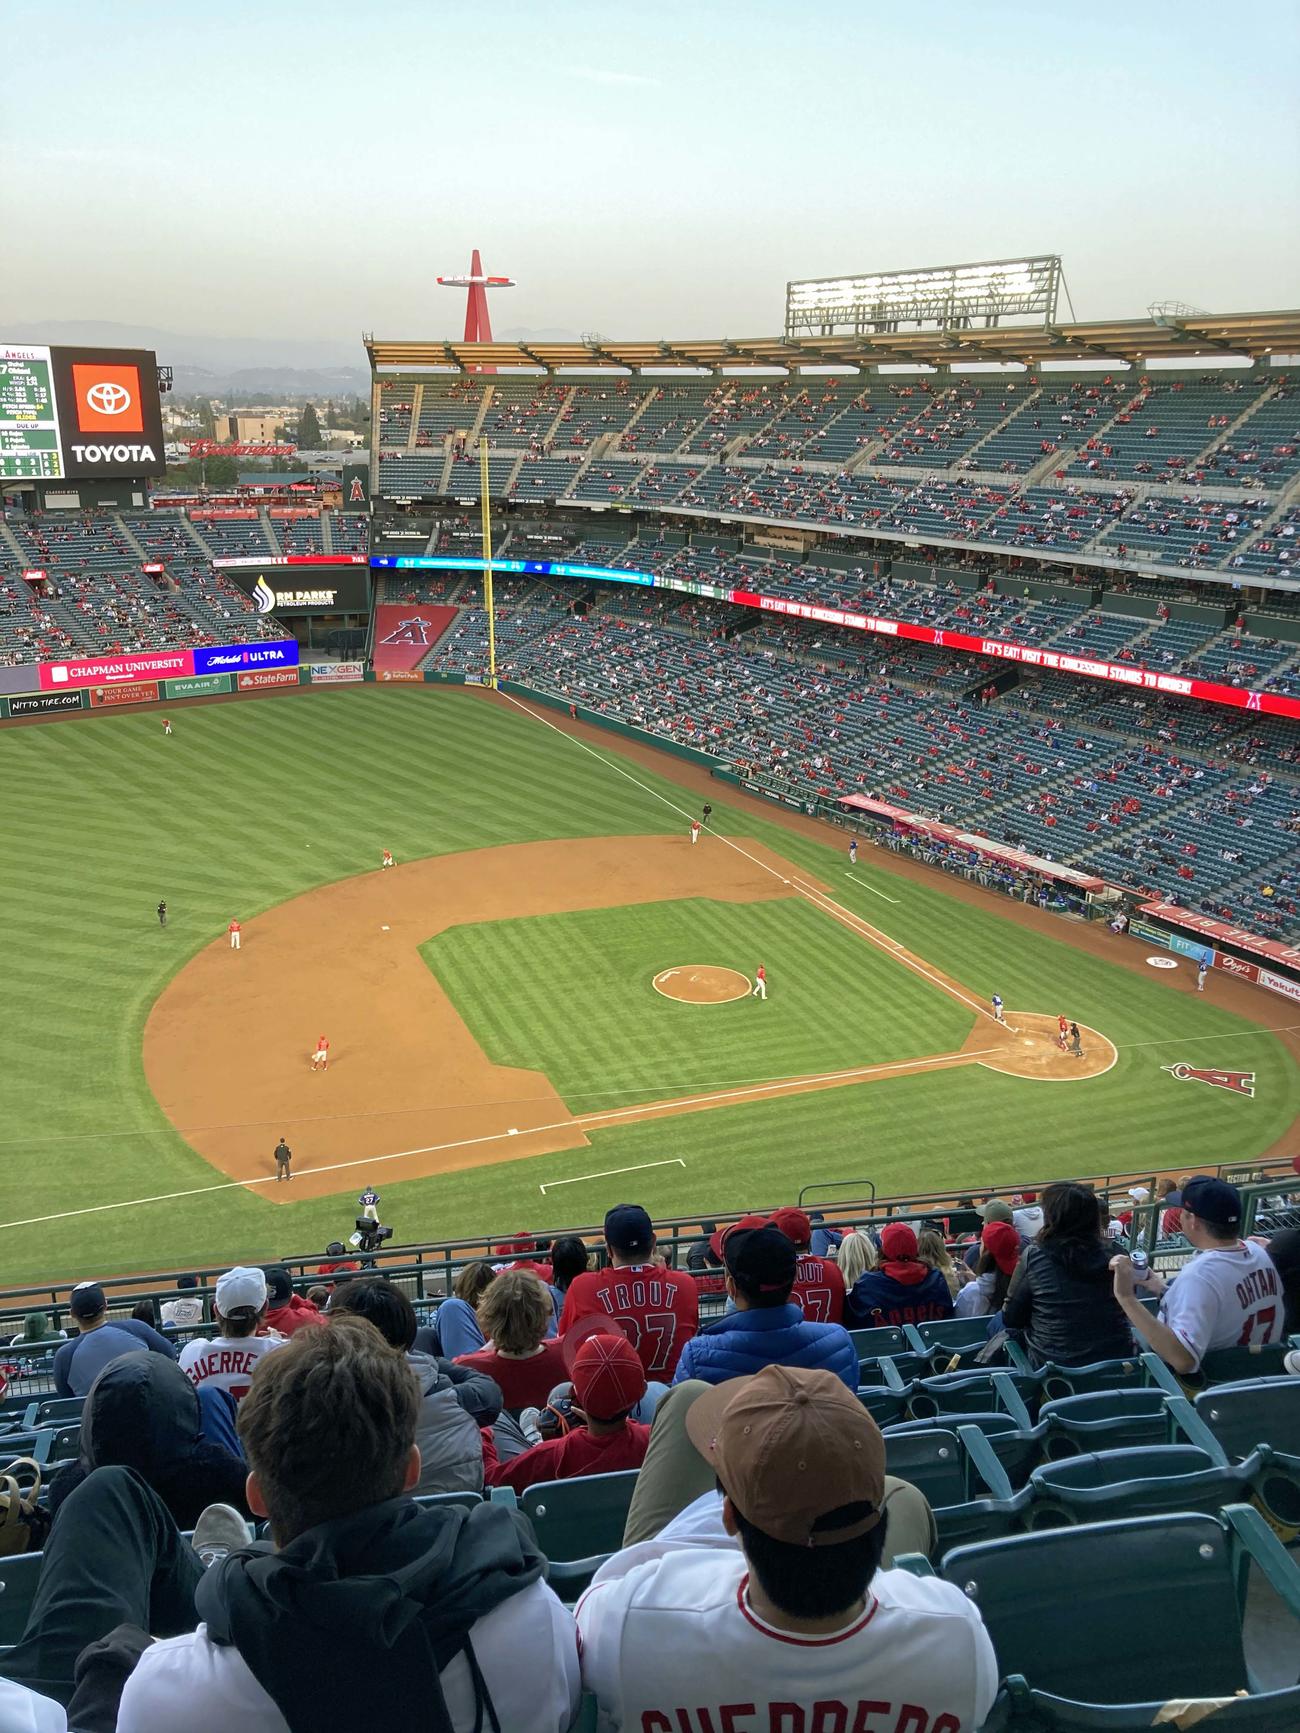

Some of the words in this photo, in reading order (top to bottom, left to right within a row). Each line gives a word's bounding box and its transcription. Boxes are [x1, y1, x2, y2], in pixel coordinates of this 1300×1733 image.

[71, 445, 156, 463] TOYOTA
[275, 591, 294, 601] RM
[296, 590, 333, 600] PARKS
[249, 650, 285, 661] ULTRA
[982, 641, 1002, 654] LET'S
[1003, 646, 1019, 657] EAT!
[69, 664, 123, 678] CHAPMAN
[125, 658, 184, 672] UNIVERSITY
[311, 665, 361, 675] NEXGEN
[104, 687, 122, 695] YOUR
[12, 700, 39, 711] NITTO
[41, 695, 80, 708] TIRE.COM
[794, 1263, 824, 1283] OUT
[597, 1281, 677, 1314] TROUT
